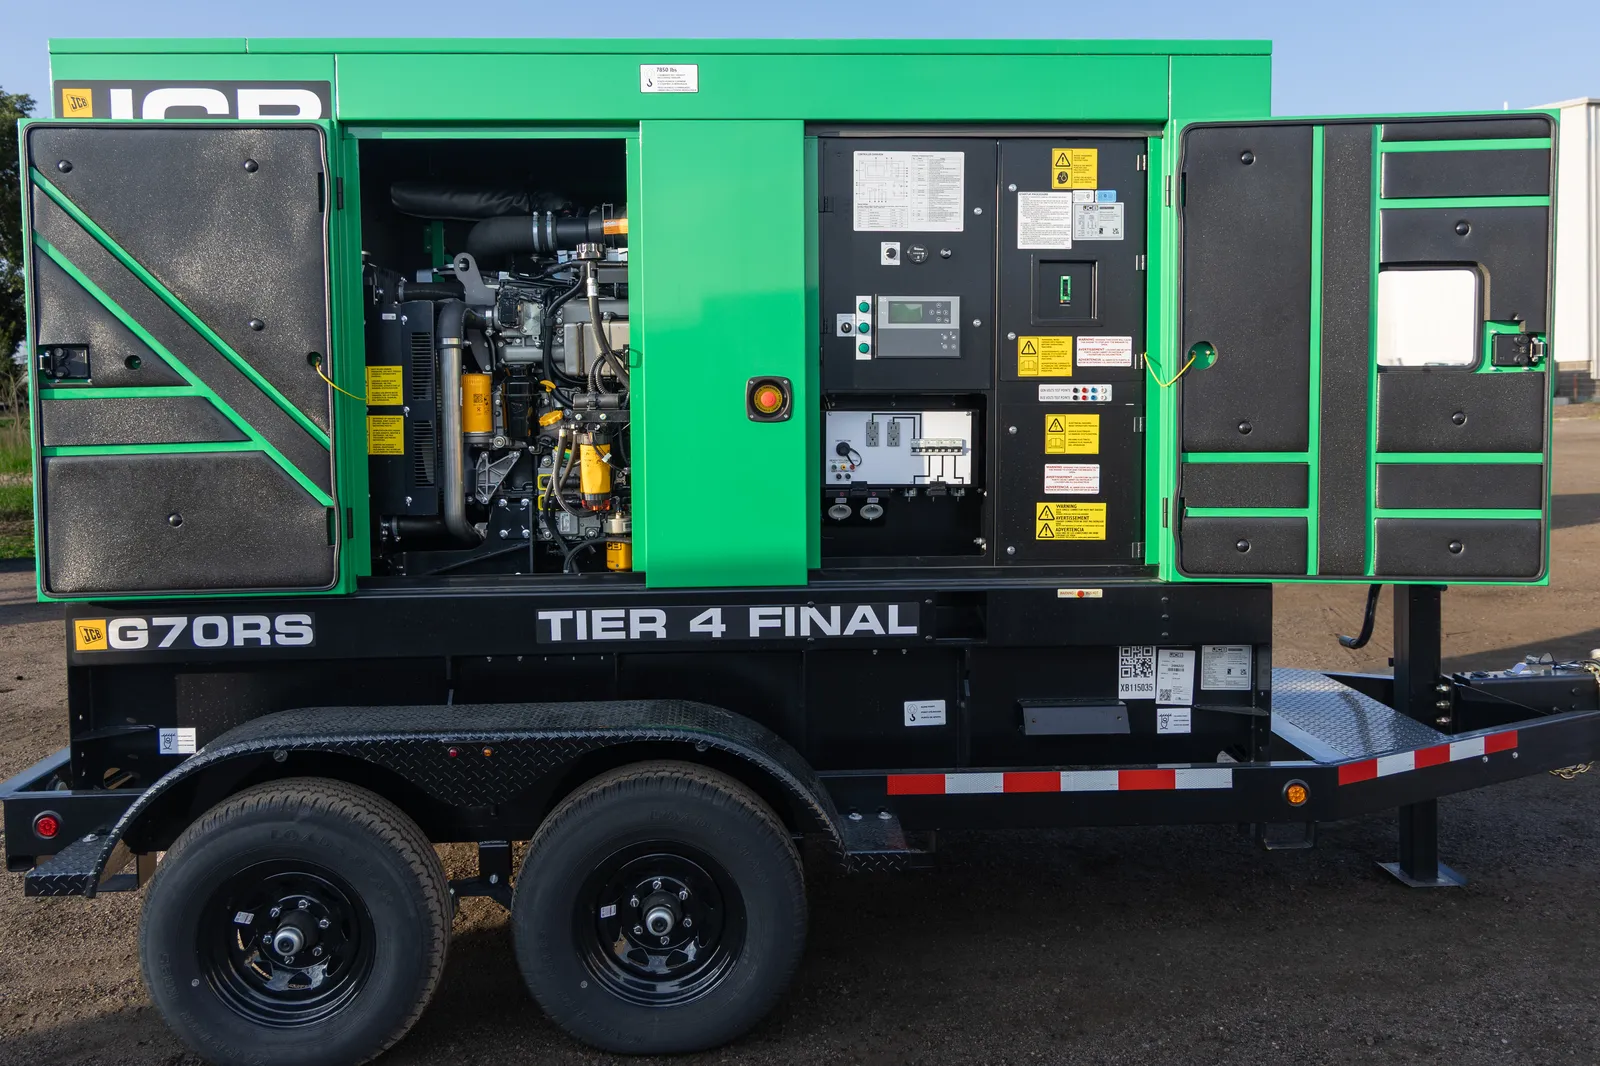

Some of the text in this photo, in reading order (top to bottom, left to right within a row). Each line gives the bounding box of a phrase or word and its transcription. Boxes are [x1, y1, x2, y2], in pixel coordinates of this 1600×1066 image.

[68, 95, 89, 111] JCB
[83, 614, 314, 649] JCB G70RS
[537, 604, 918, 641] TIER 4 FINAL
[1120, 683, 1153, 692] XB115035
